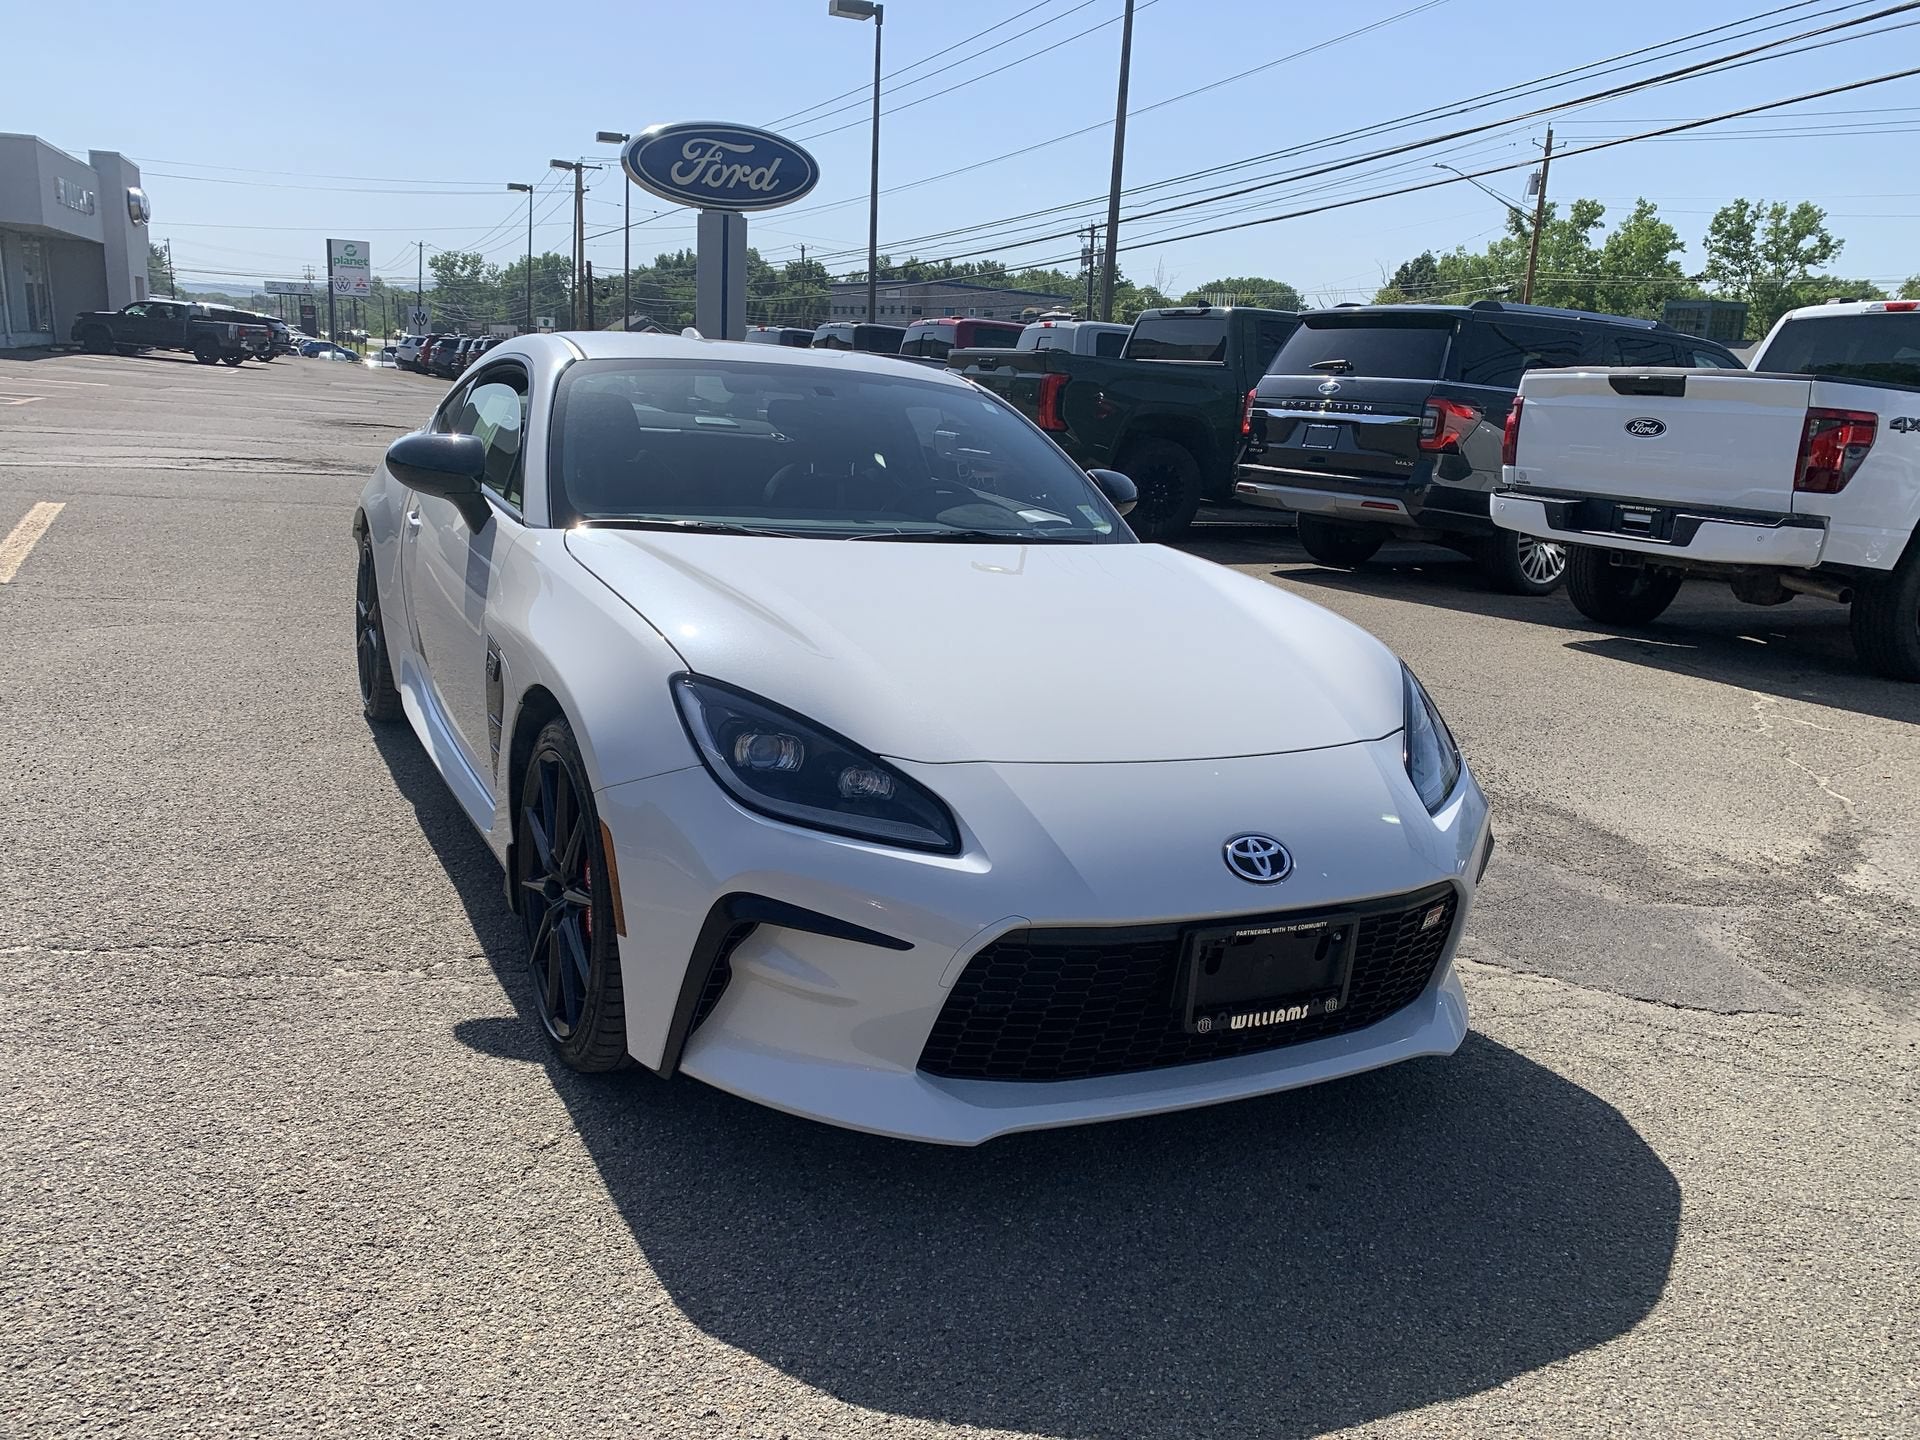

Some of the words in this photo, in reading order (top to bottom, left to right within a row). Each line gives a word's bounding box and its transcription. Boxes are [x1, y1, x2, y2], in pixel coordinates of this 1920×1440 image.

[671, 138, 783, 192] Ford
[333, 256, 369, 266] planet
[1281, 401, 1373, 411] EXPEDITION
[1631, 420, 1659, 434] Ford
[1236, 928, 1271, 936] PARTNERING
[1298, 921, 1328, 930] COMMUNITY
[1230, 1004, 1309, 1030] WILLIAMS
